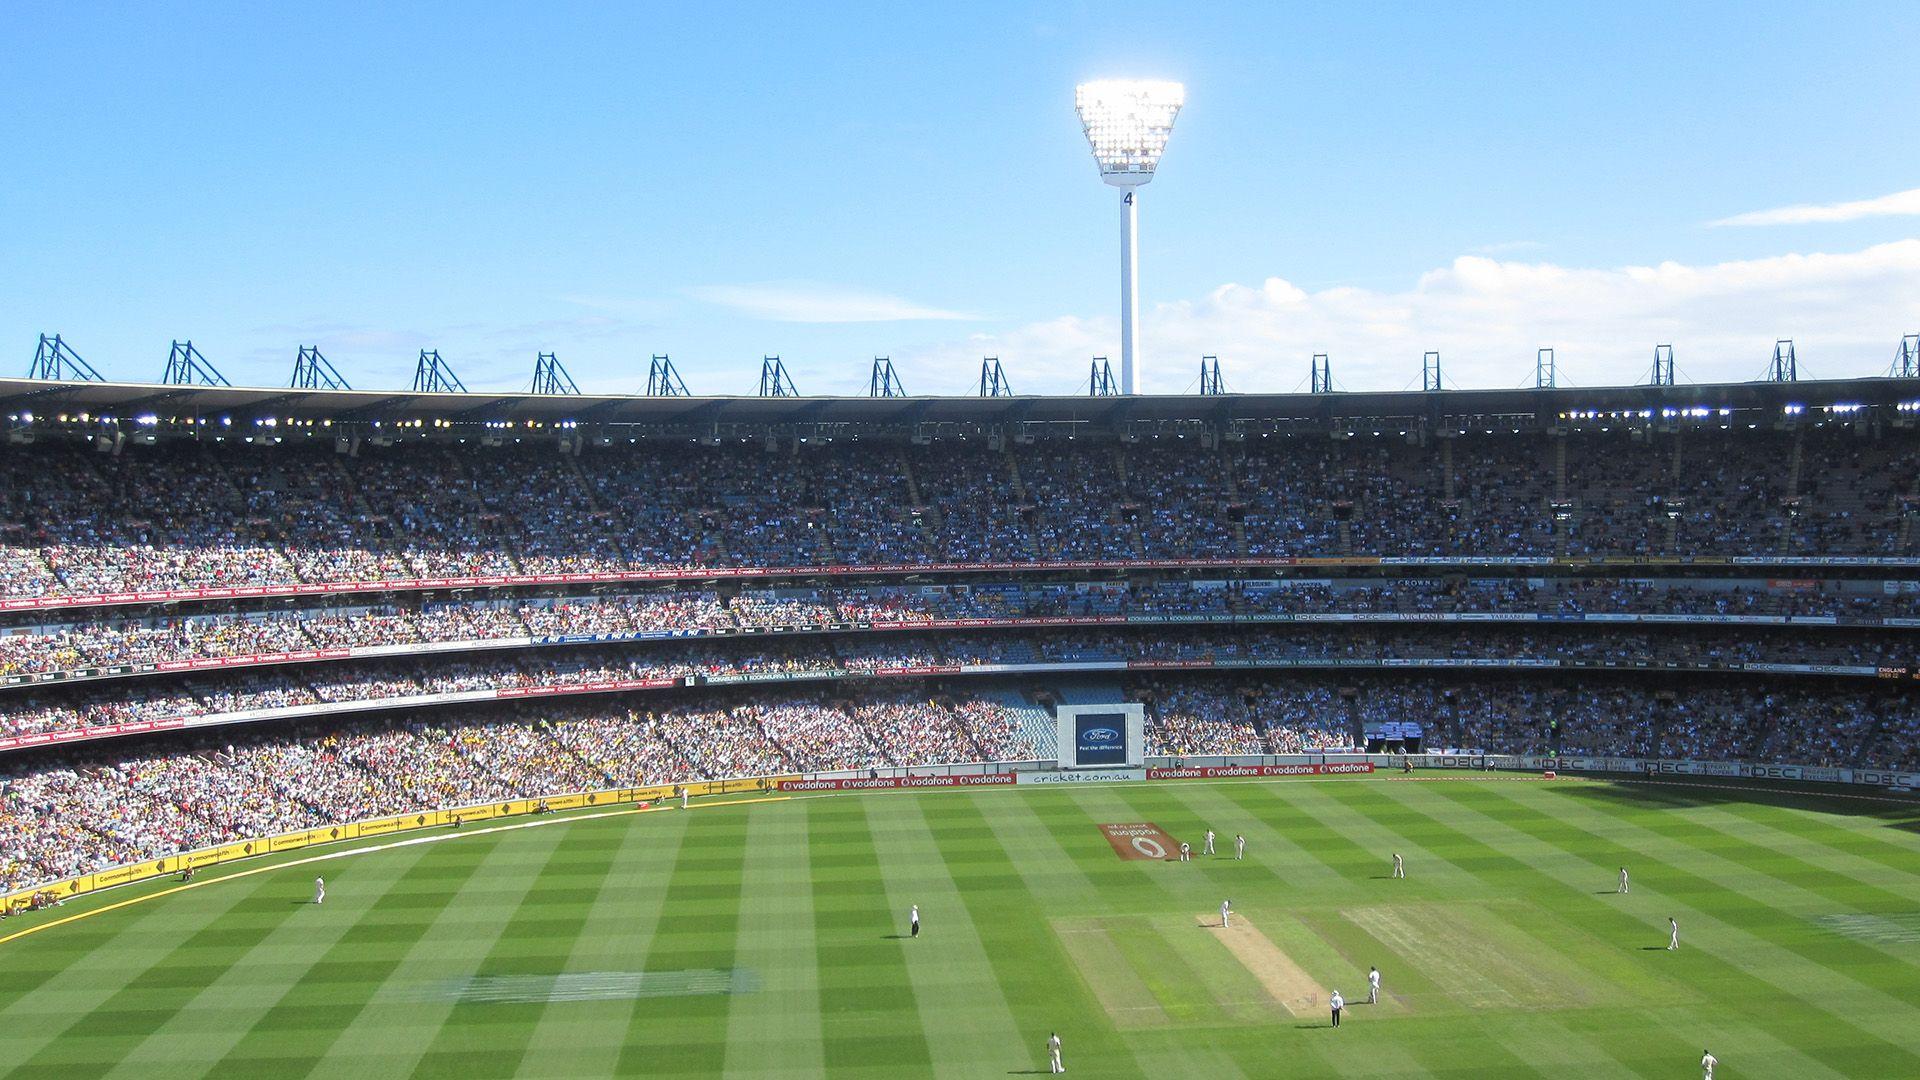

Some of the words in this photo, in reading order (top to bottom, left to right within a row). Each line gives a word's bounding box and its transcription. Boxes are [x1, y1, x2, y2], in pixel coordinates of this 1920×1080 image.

[1124, 192, 1133, 206] 4
[1089, 730, 1111, 740] Ford
[1159, 768, 1202, 778] vodafone
[1215, 766, 1258, 777] vodafone
[1271, 764, 1314, 775] vodafone
[1327, 763, 1370, 774] vodafone
[852, 779, 895, 788] vodafone
[910, 776, 953, 787] vodafone
[968, 775, 1012, 785] vodafone
[1033, 773, 1131, 784] cricket.com.au
[792, 780, 836, 790] vodafone
